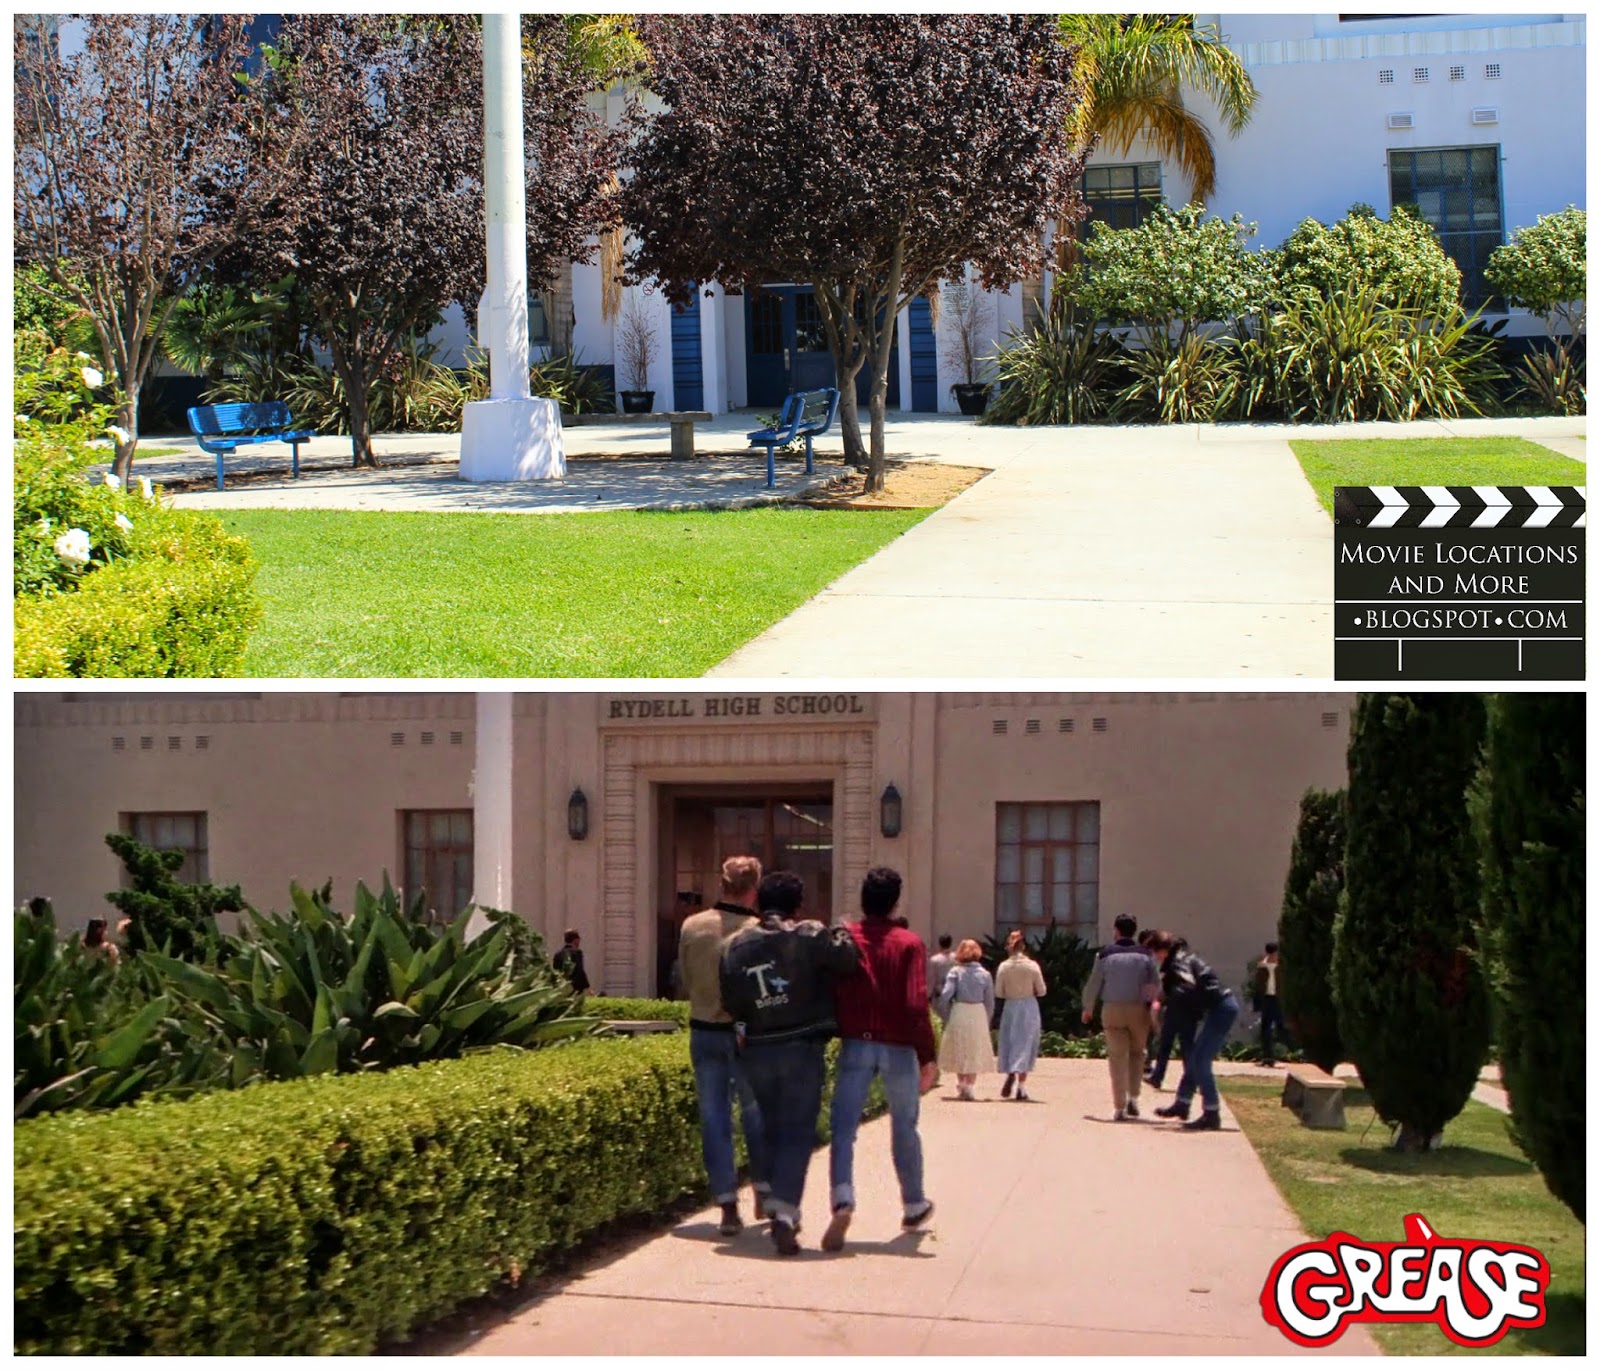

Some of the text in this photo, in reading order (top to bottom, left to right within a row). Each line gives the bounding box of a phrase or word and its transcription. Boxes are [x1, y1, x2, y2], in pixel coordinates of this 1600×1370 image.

[608, 695, 863, 719] RYDELL HIGH SCHOOL
